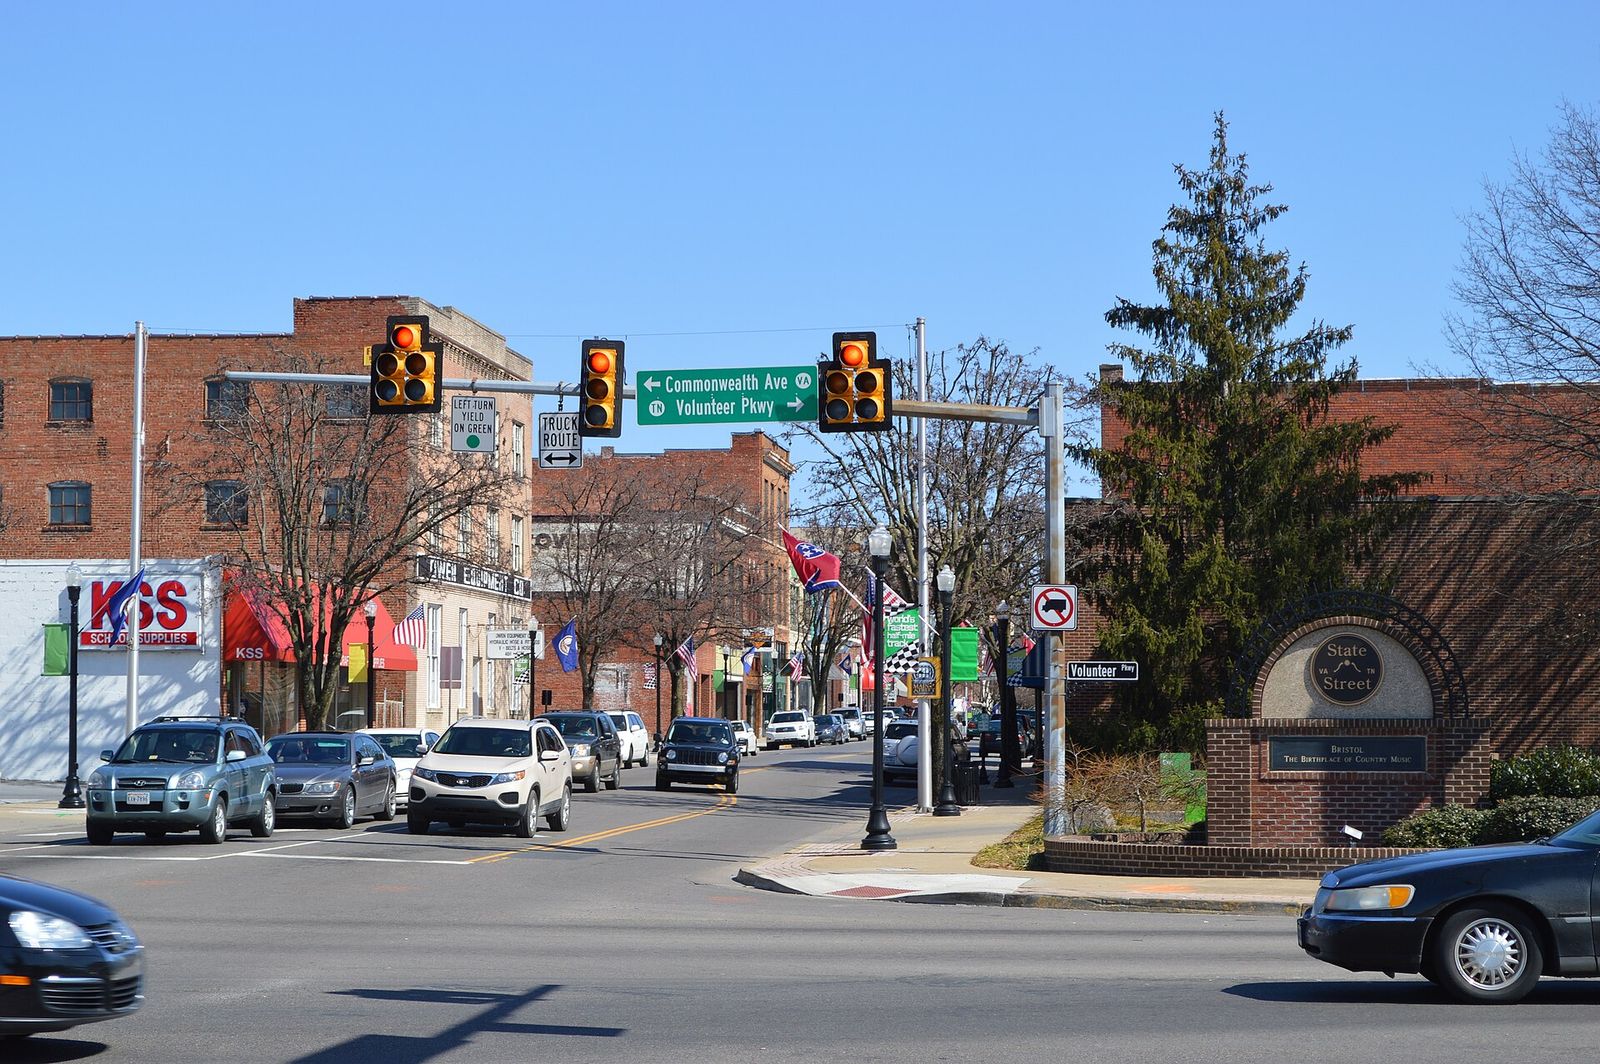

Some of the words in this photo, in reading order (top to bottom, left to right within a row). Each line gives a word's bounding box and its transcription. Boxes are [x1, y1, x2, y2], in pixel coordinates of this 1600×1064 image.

[665, 372, 759, 393] Commonwealth
[764, 373, 788, 390] Ave
[796, 375, 811, 387] VA
[454, 400, 470, 410] LEFT
[474, 400, 493, 410] TURN
[650, 403, 663, 414] TN
[676, 398, 736, 416] Volunteer
[741, 397, 774, 418] Pkwy
[461, 412, 485, 422] YIELD
[454, 423, 465, 433] ON
[467, 424, 492, 434] GREEN
[542, 417, 578, 431] TRUCK
[543, 434, 578, 447] ROUTE
[463, 567, 509, 593] EQUIPMENT
[887, 614, 916, 624] world's
[887, 623, 919, 632] fastest
[139, 633, 188, 644] SUPPLIES
[887, 632, 916, 640] half-mile
[887, 639, 909, 649] track
[1327, 643, 1367, 656] State
[236, 648, 263, 659] KSS
[1071, 664, 1117, 677] Volunteer
[1121, 664, 1135, 673] Pkwy
[1324, 677, 1371, 690] Street
